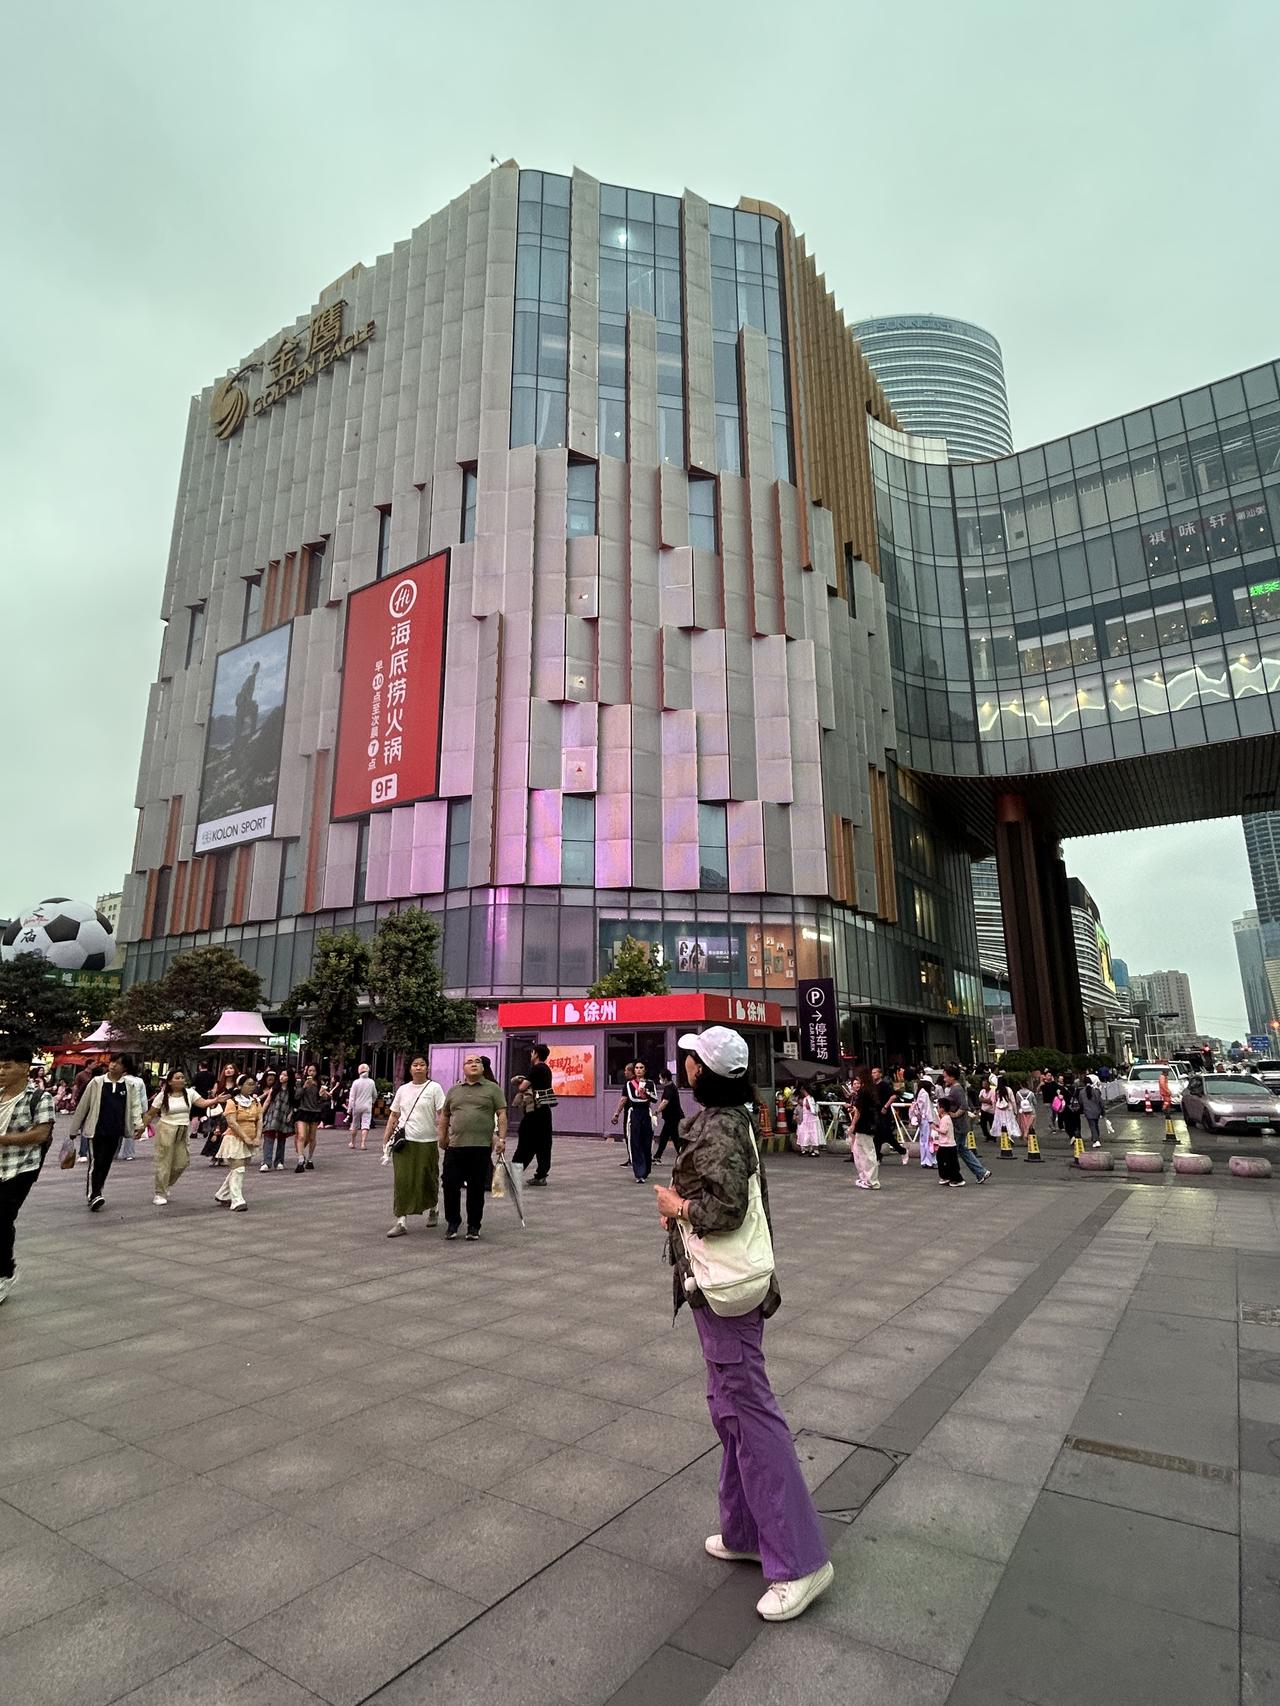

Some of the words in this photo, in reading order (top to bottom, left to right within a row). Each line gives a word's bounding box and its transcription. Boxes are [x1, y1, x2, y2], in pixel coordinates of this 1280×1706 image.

[266, 299, 349, 388] 金鹰
[253, 359, 315, 416] GOLDEN
[319, 320, 376, 366] EAGLE
[394, 588, 410, 611] Hi
[383, 619, 411, 766] 海底捞火锅
[375, 778, 393, 799] 9F
[212, 824, 239, 841] KOLON
[241, 817, 267, 834] SPORT
[583, 1000, 617, 1022] 徐州
[747, 1001, 766, 1023] 徐州
[815, 1023, 828, 1060] 停车场
